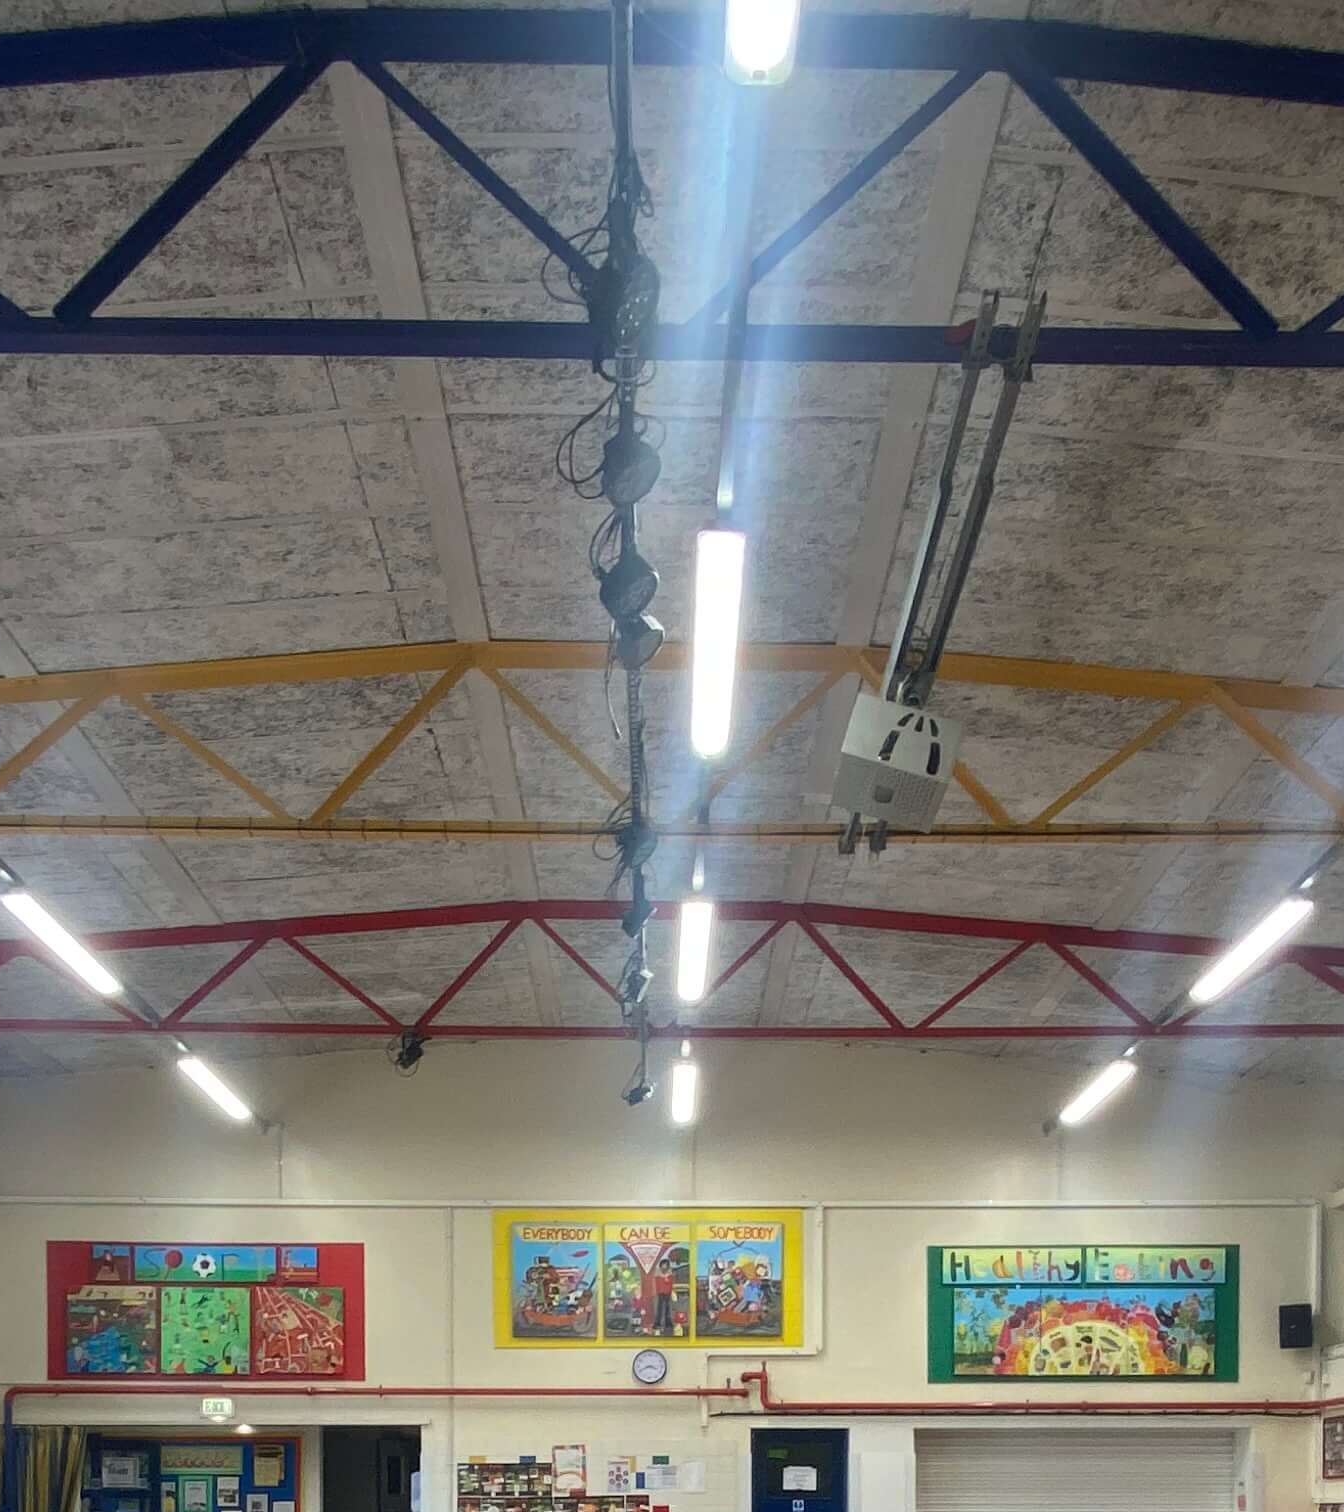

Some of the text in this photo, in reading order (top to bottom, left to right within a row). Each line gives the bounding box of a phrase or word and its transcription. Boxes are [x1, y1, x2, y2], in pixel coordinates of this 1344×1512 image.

[522, 1225, 775, 1241] EVERYBODY CAN BE SOMEBODY
